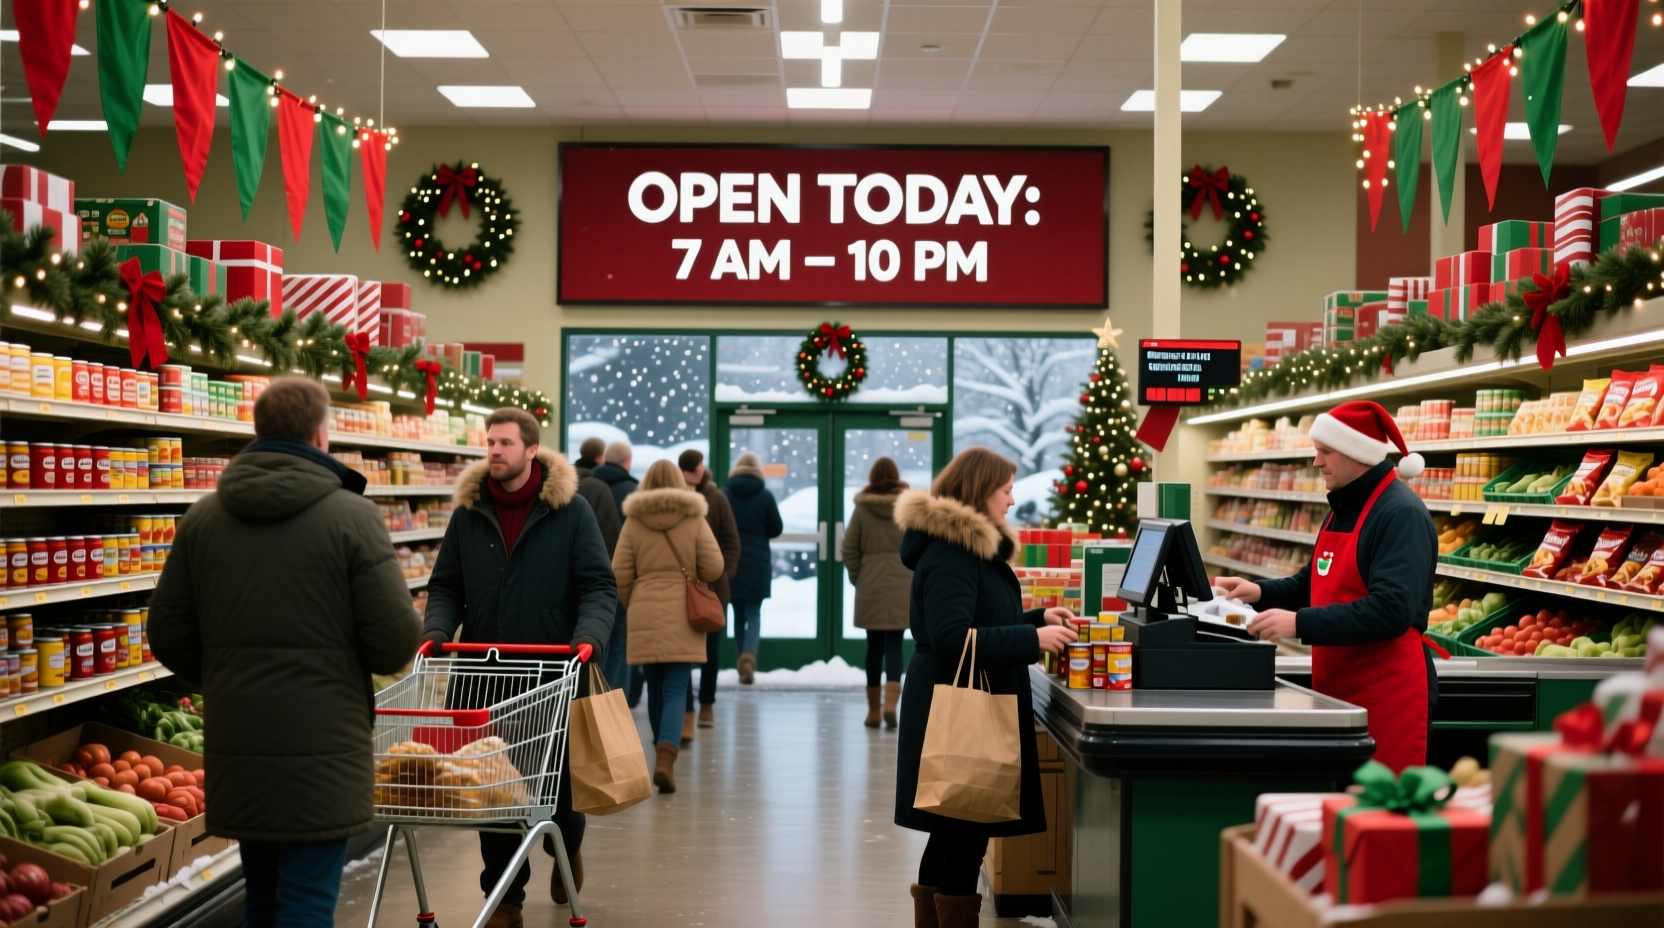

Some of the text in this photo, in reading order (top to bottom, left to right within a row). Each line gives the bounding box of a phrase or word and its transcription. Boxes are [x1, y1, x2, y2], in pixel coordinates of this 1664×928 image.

[627, 171, 1041, 226] OPEN TODAY:
[671, 238, 703, 280] 7
[709, 238, 791, 281] AM
[847, 239, 901, 282] 10
[914, 240, 988, 282] PM
